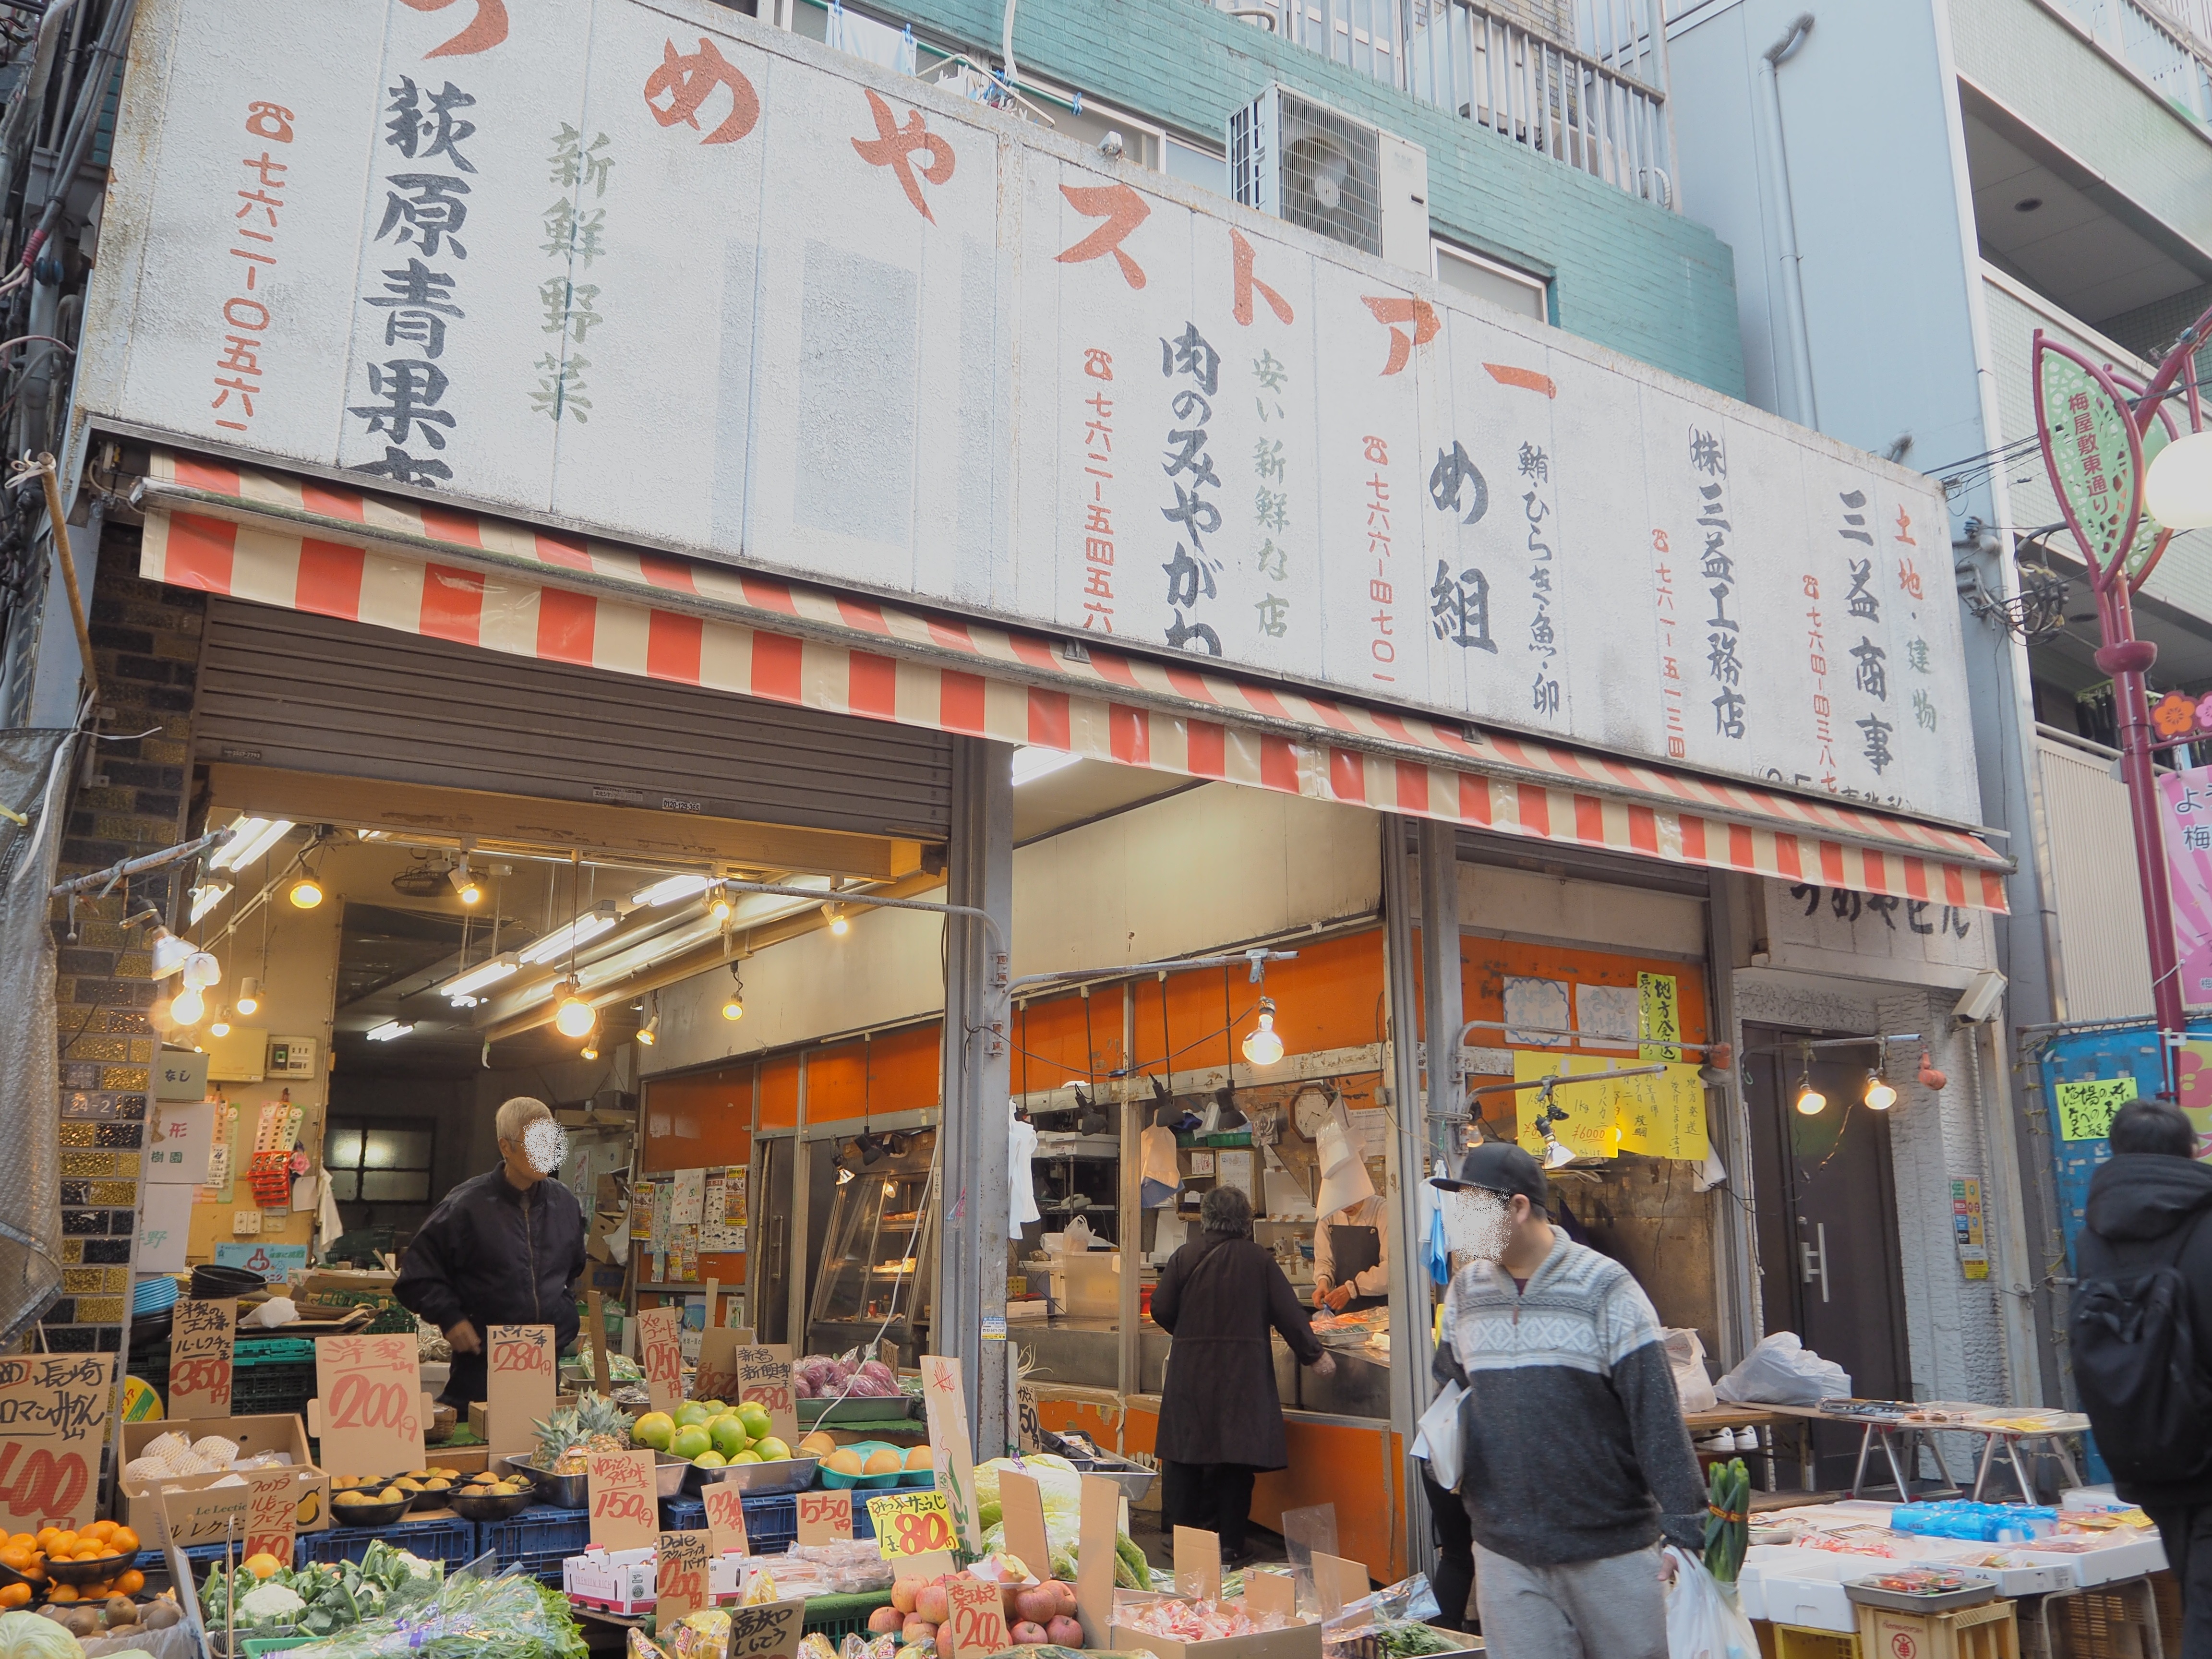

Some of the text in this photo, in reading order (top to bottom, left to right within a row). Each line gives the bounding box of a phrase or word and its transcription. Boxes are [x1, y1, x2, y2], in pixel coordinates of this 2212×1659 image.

[528, 122, 615, 423] 新鮮野菜
[2068, 393, 2108, 515] 梅屋敷東通り
[1159, 321, 1224, 656] 肉のみやがわ
[1251, 349, 1290, 638] 安い新鮮な店
[1429, 440, 1498, 655] め組
[1839, 490, 1894, 776] 三益商事
[663, 800, 699, 812] 0120-129-365
[2177, 787, 2212, 812] よ
[2183, 824, 2212, 850] 梅
[165, 1070, 191, 1082] なし
[1596, 1080, 1609, 1128] ラバカニ
[1684, 1078, 1701, 1135] 地方発送
[1572, 1124, 1605, 1142] ¥6000
[181, 1312, 230, 1334] 王様
[493, 1325, 544, 1339] パイン
[323, 1338, 406, 1364] 洋梨
[493, 1342, 552, 1376] 280円
[32, 1358, 105, 1388] 長崎
[169, 1358, 230, 1406] 350円
[646, 1343, 682, 1398] 250円
[329, 1374, 418, 1443] 200円
[1019, 1404, 1040, 1450] 50円
[196, 1506, 210, 1515] Le
[594, 1491, 654, 1528] 150円
[802, 1497, 851, 1531] 550円
[244, 1534, 289, 1566] 150
[660, 1534, 697, 1550] Dole
[895, 1512, 956, 1555] 80円
[659, 1558, 703, 1609] 200円
[734, 1609, 793, 1641] 高知
